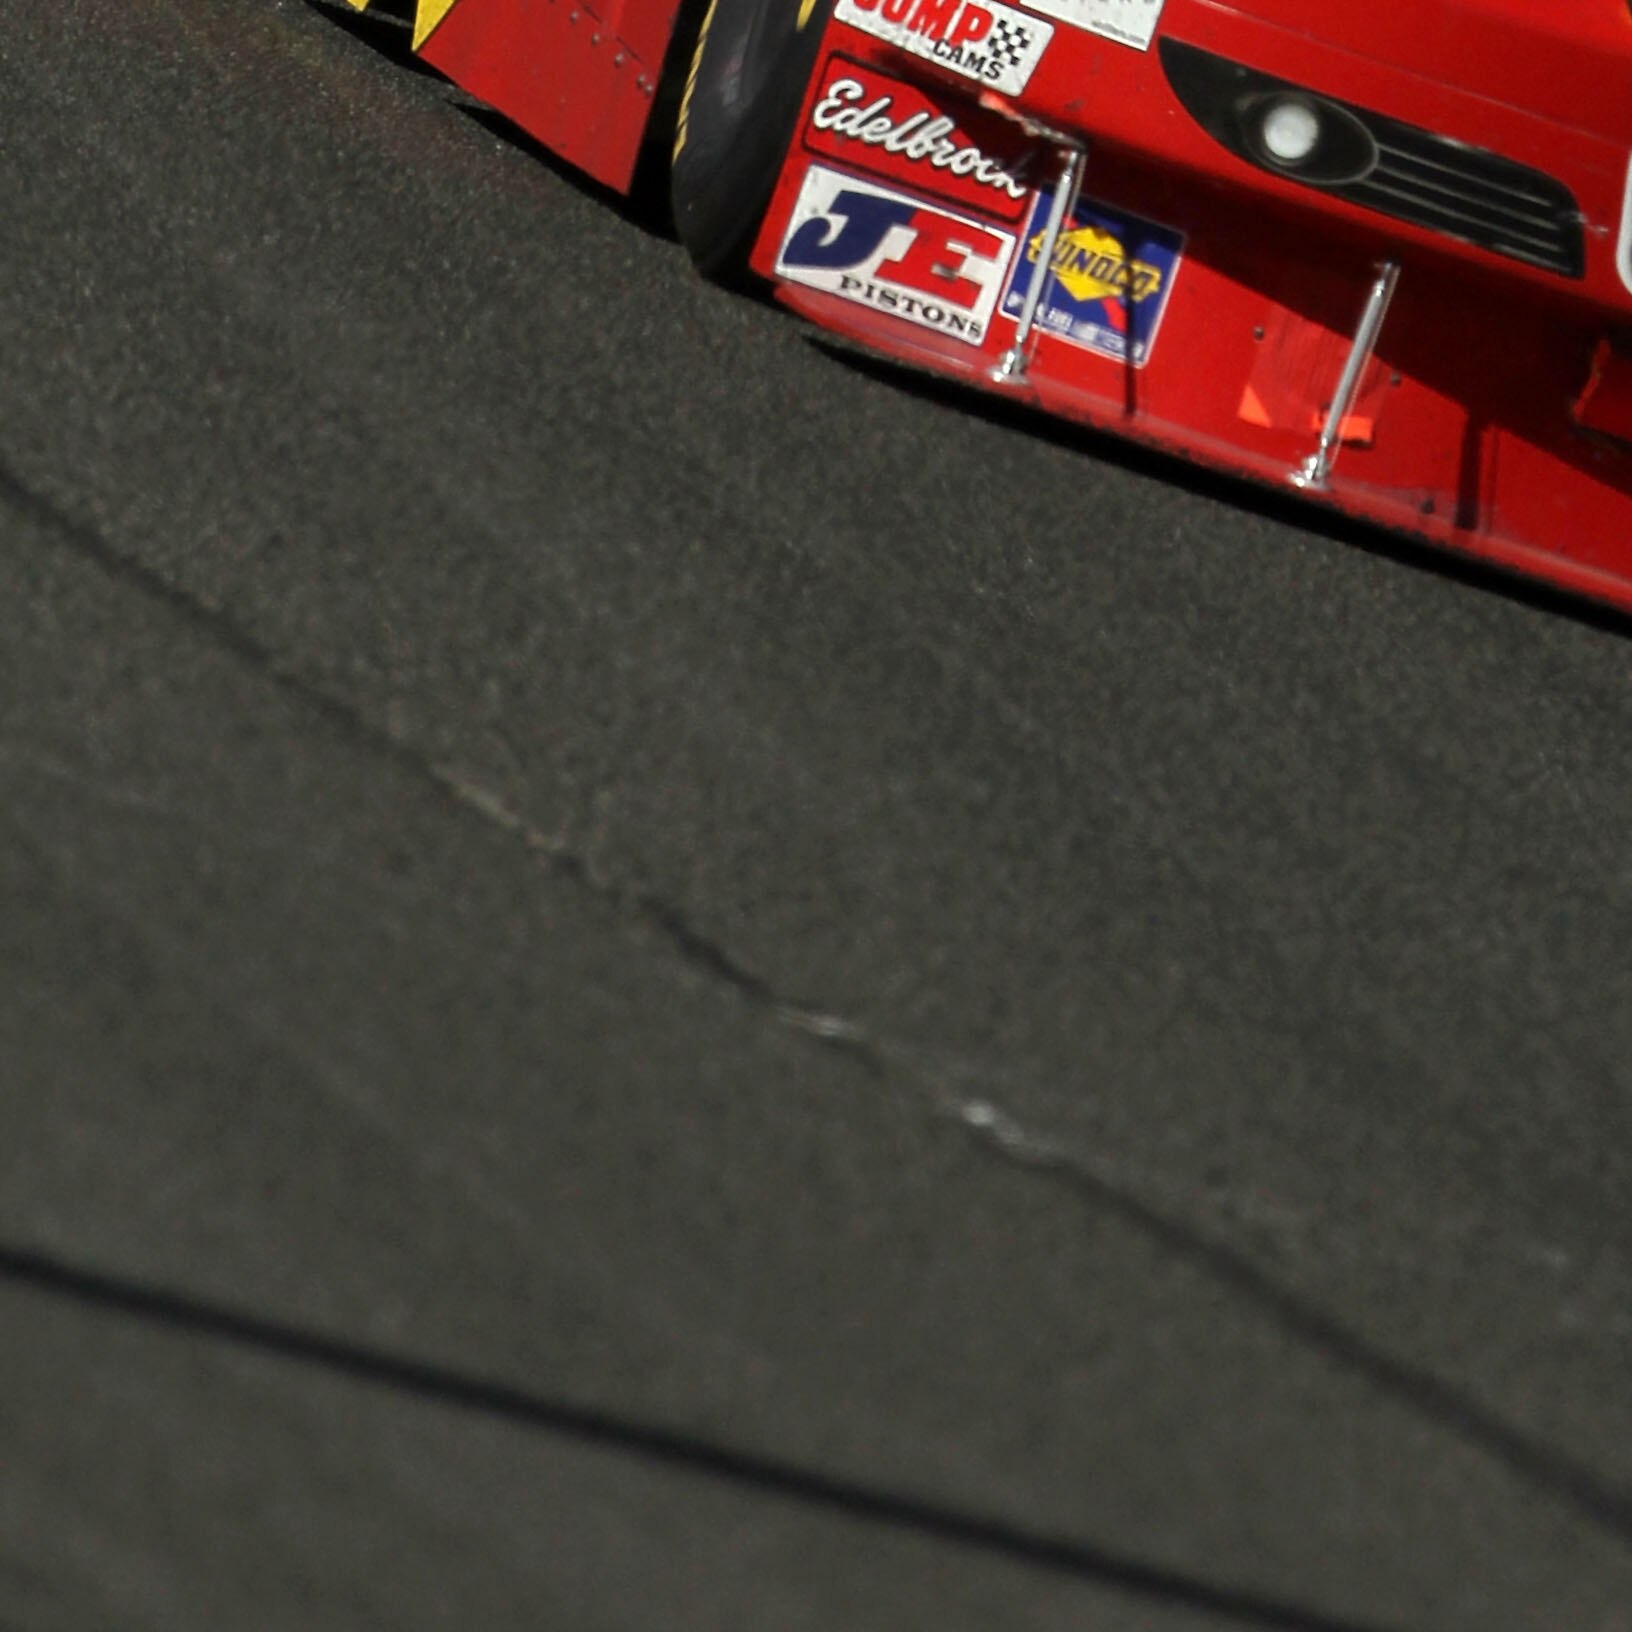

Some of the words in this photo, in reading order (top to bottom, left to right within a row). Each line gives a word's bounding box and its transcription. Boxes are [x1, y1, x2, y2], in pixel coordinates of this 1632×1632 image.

[932, 36, 1005, 81] CAMS
[782, 190, 1008, 309] JE
[839, 275, 982, 337] PISTONS
